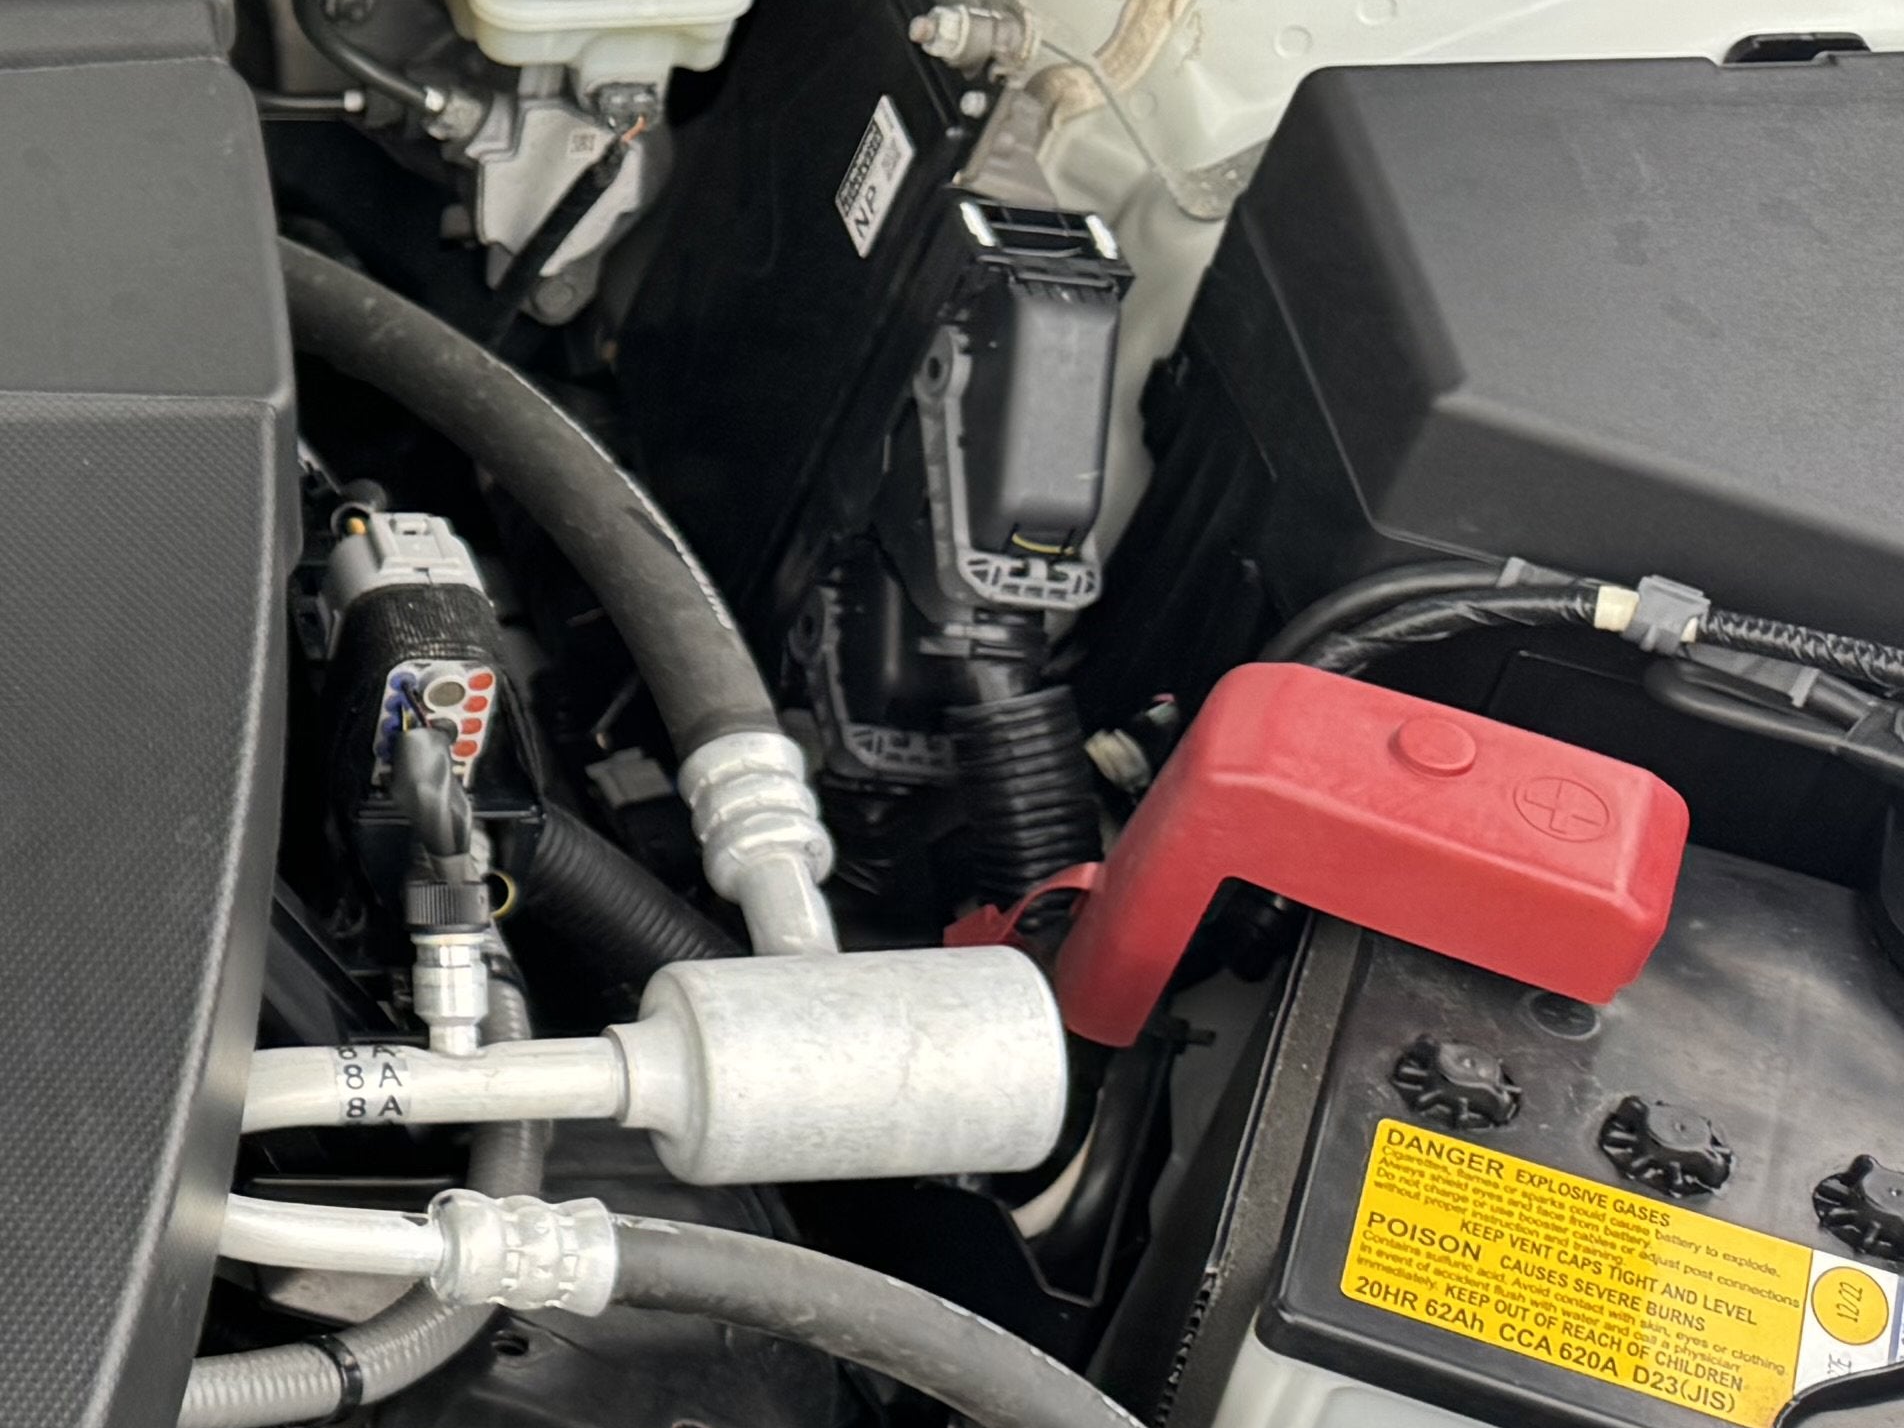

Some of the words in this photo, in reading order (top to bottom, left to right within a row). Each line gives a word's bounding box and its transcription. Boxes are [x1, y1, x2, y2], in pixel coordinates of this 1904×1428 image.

[343, 1064, 364, 1089] 8
[379, 1062, 402, 1088] A
[346, 1097, 366, 1118] 8
[378, 1095, 403, 1116] A
[1386, 1128, 1506, 1179] DANGER
[1514, 1169, 1608, 1209] EXPLOSIVE
[1611, 1198, 1671, 1228] GASES
[1366, 1210, 1482, 1262] POISON
[1499, 1254, 1569, 1289] CAUSES
[1571, 1277, 1642, 1311] SEVERE
[1644, 1300, 1706, 1332] BURNS
[1422, 1181, 1469, 1205] charge
[1620, 1245, 1634, 1256] or
[1638, 1248, 1680, 1271] adjust
[1683, 1263, 1713, 1282] post
[1716, 1274, 1801, 1309] connections
[1459, 1218, 1504, 1244] KEEP
[1507, 1234, 1553, 1260] VENT
[1555, 1249, 1603, 1276] CAPS
[1607, 1265, 1658, 1294] TIGHT
[1660, 1282, 1698, 1306] AND
[1701, 1295, 1759, 1326] LEVEL
[1568, 1215, 1599, 1233] from
[1603, 1225, 1653, 1250] battery.
[1568, 1203, 1606, 1223] could
[1609, 1217, 1650, 1236] cause
[1653, 1229, 1701, 1255] battery
[1705, 1245, 1718, 1258] to
[1721, 1251, 1782, 1279] explode.
[1354, 1275, 1419, 1311] 20HR
[1424, 1298, 1486, 1332] 62Ah
[1497, 1321, 1555, 1355] CCA
[1558, 1342, 1621, 1377] 620A
[1631, 1364, 1737, 1415] D23(JIS)
[1444, 1283, 1490, 1309] KEEP
[1493, 1298, 1530, 1322] OUT
[1532, 1311, 1558, 1331] OF
[1560, 1320, 1622, 1352] REACH
[1626, 1341, 1651, 1360] OF
[1653, 1350, 1744, 1391] CHILDREN
[1553, 1291, 1604, 1315] contact
[1608, 1308, 1636, 1325] with
[1640, 1318, 1671, 1337] skin,
[1674, 1330, 1708, 1350] eyes
[1712, 1343, 1727, 1354] or
[1602, 1320, 1629, 1336] and
